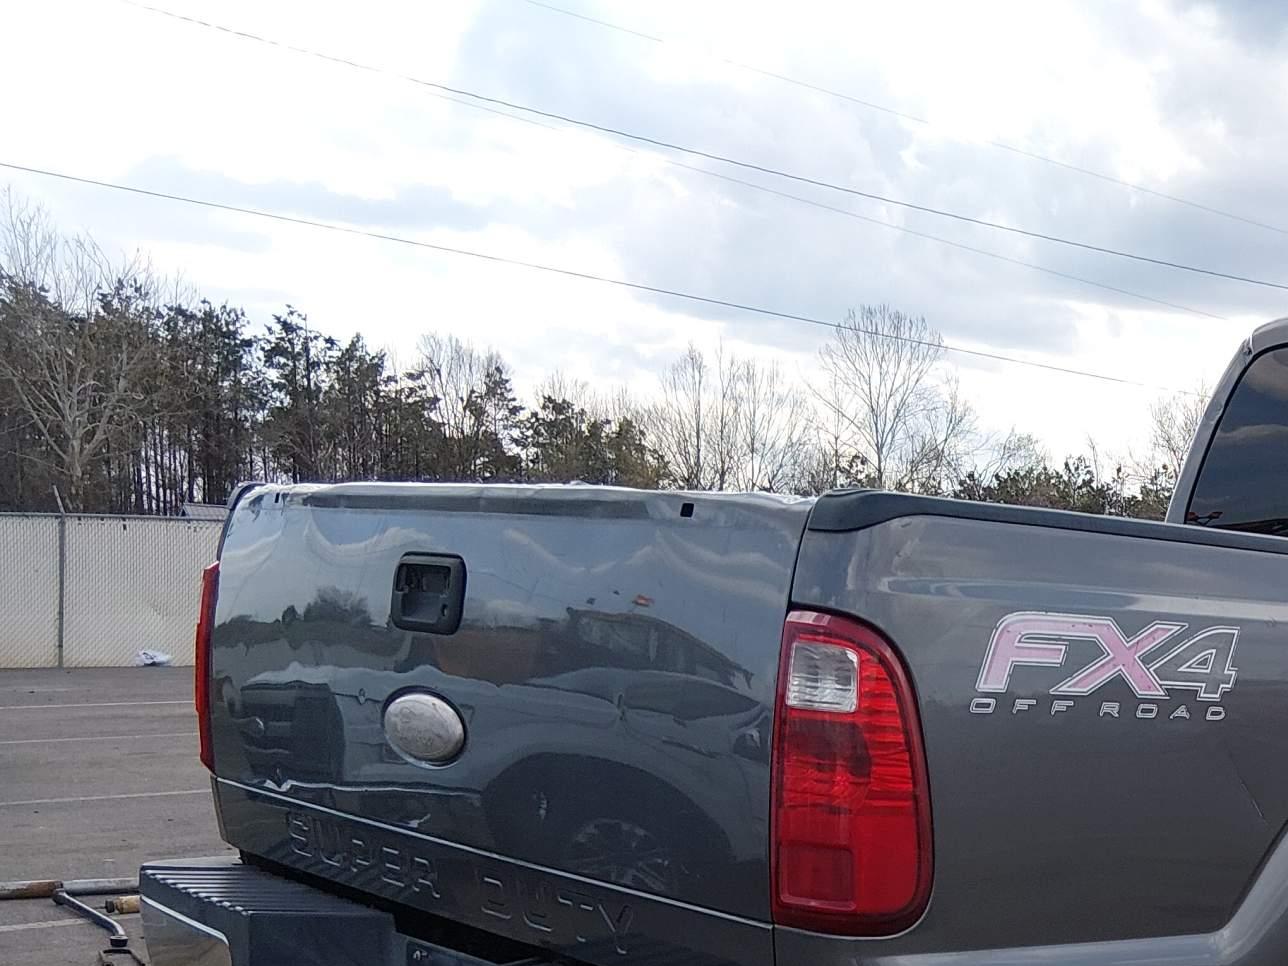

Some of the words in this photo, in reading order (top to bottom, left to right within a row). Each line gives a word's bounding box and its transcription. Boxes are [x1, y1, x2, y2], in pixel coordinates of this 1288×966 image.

[975, 611, 1241, 702] FX4
[969, 697, 1075, 716] OFF
[1099, 700, 1227, 722] ROAD
[286, 808, 441, 899] SUPER
[478, 868, 633, 955] DUTY
